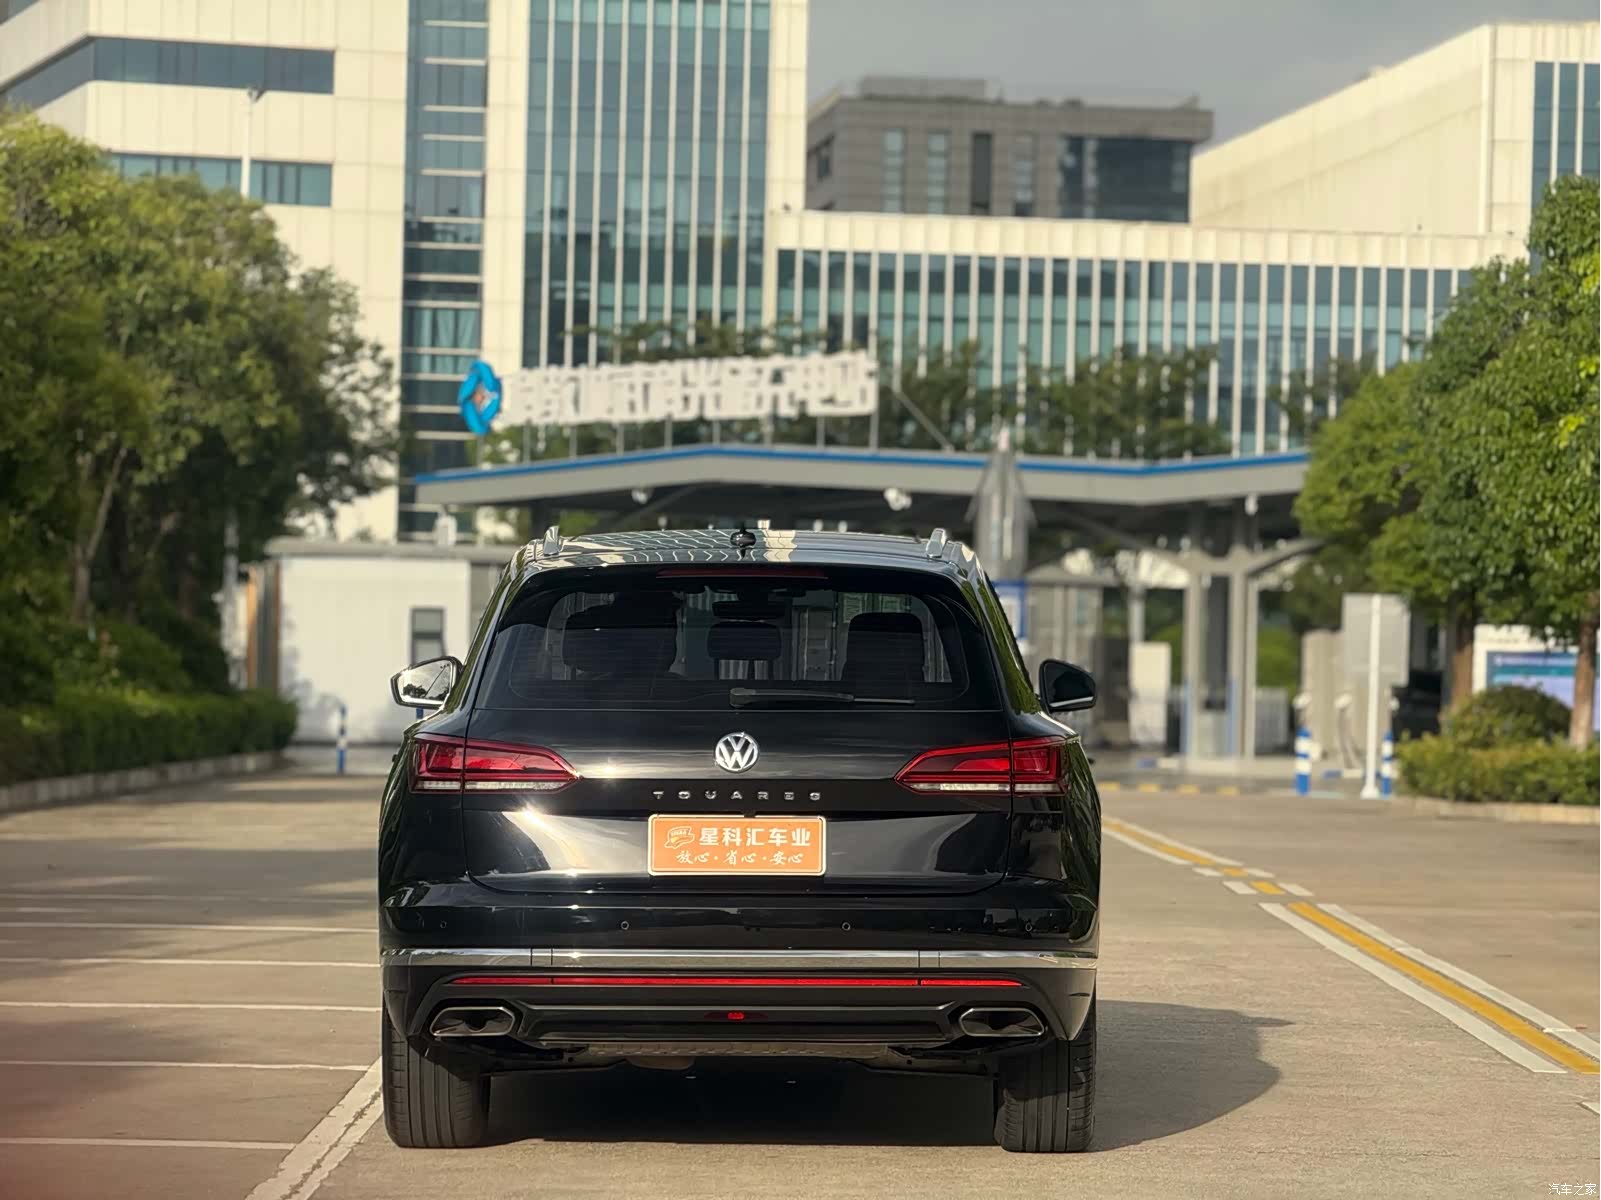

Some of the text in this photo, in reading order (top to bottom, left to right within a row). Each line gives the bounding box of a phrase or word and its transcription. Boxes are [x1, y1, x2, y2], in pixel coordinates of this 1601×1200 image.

[653, 791, 820, 800] TOUAREG
[699, 827, 811, 847] 星科汇车业
